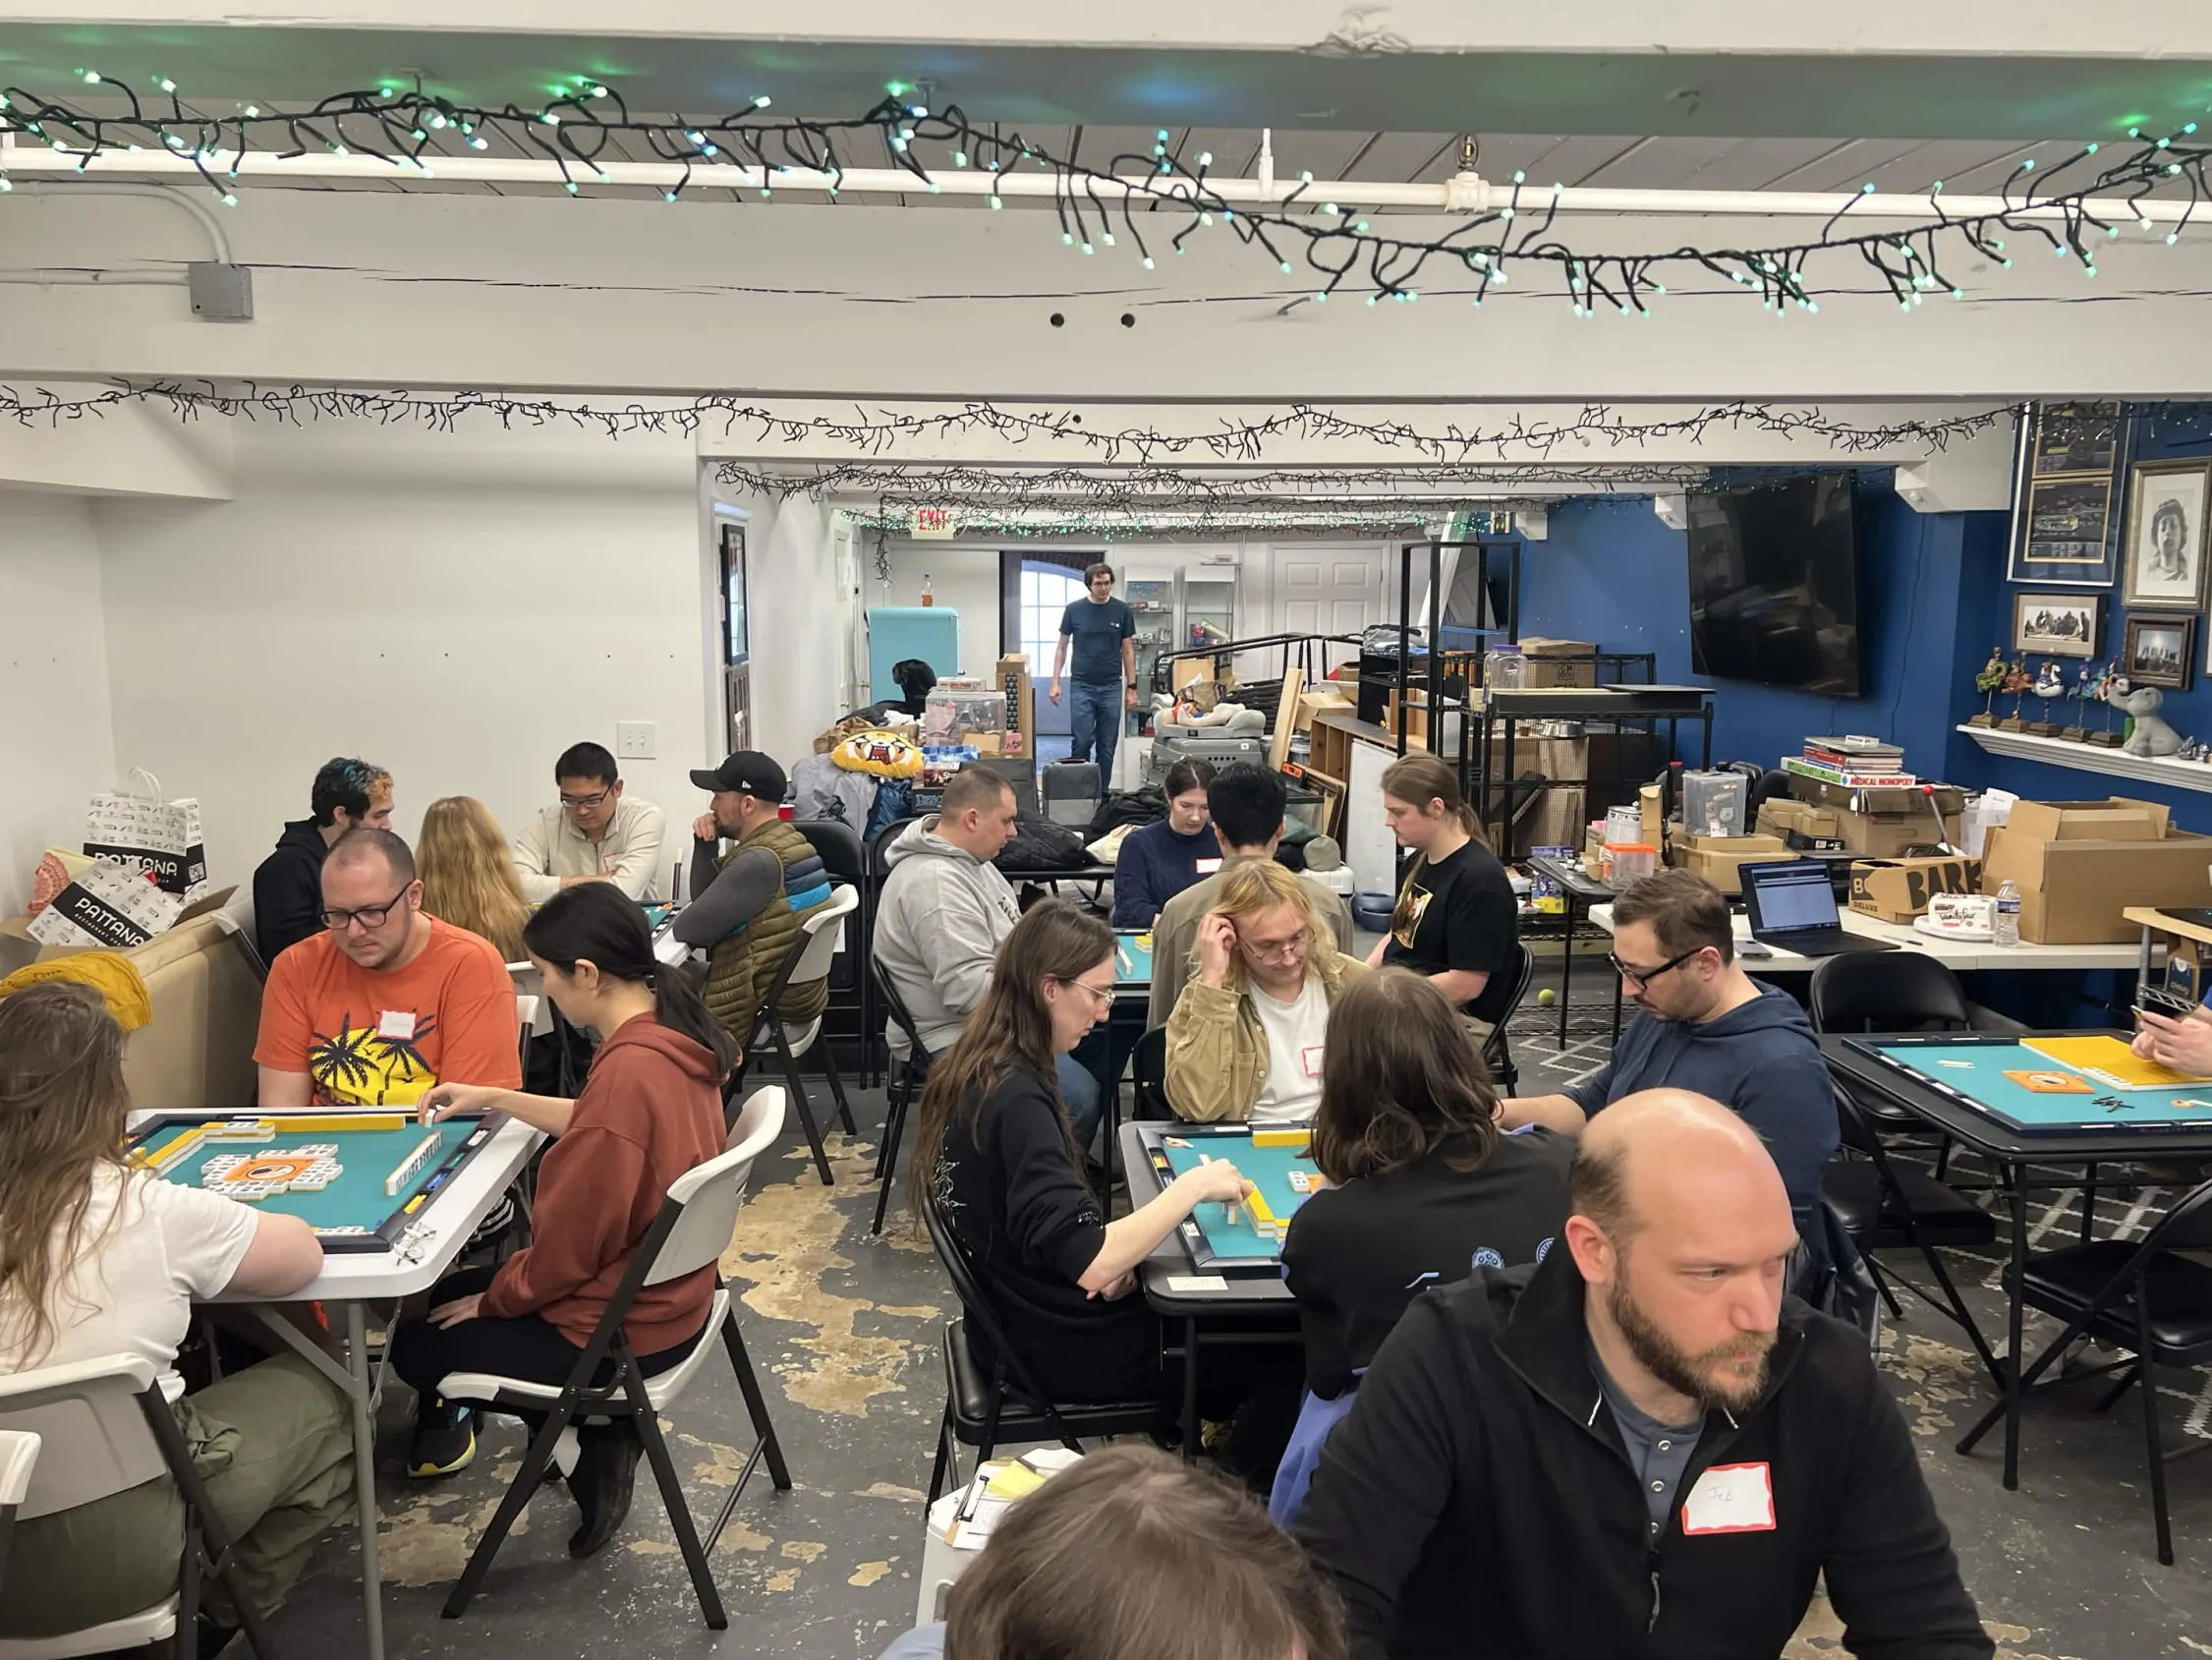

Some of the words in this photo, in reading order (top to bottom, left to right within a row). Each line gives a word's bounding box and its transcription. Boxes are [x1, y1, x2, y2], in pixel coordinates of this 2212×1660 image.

[919, 509, 947, 531] EXIT
[1849, 775, 1877, 786] MEDICAL
[1879, 776, 1913, 786] MONOPOLY
[1906, 860, 1983, 910] BARK
[1853, 901, 1878, 913] DELUXE
[75, 897, 144, 946] PATTANA
